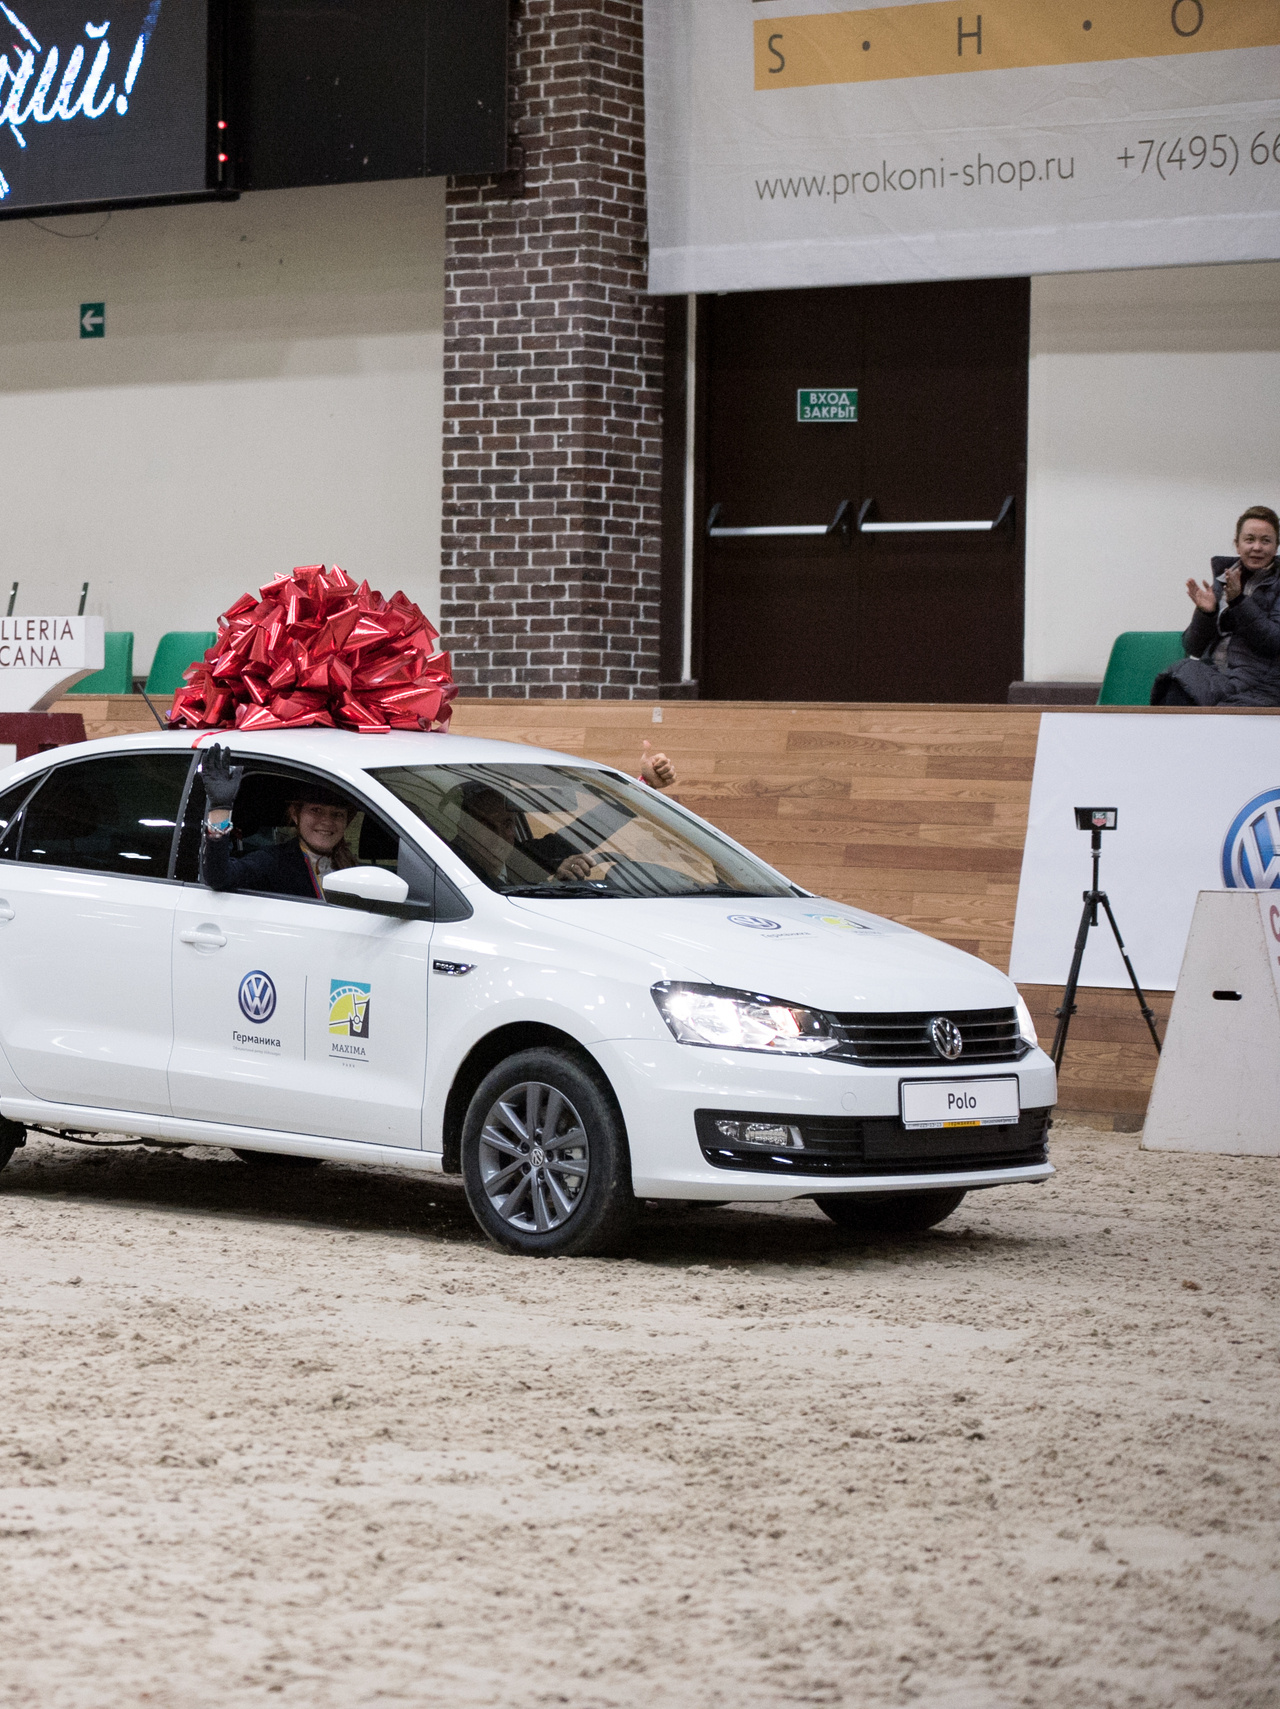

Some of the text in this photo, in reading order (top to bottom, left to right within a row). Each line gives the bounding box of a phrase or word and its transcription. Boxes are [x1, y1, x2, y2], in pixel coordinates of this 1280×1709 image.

[1117, 134, 1239, 181] +7(495)
[755, 152, 1075, 204] www.prokoni-shop.ru
[809, 392, 850, 406] ВХОД
[803, 406, 856, 418] ЗАКРЫТ
[232, 1030, 281, 1048] Германика
[331, 1042, 366, 1056] MAXIMA
[947, 1092, 977, 1109] Polo
